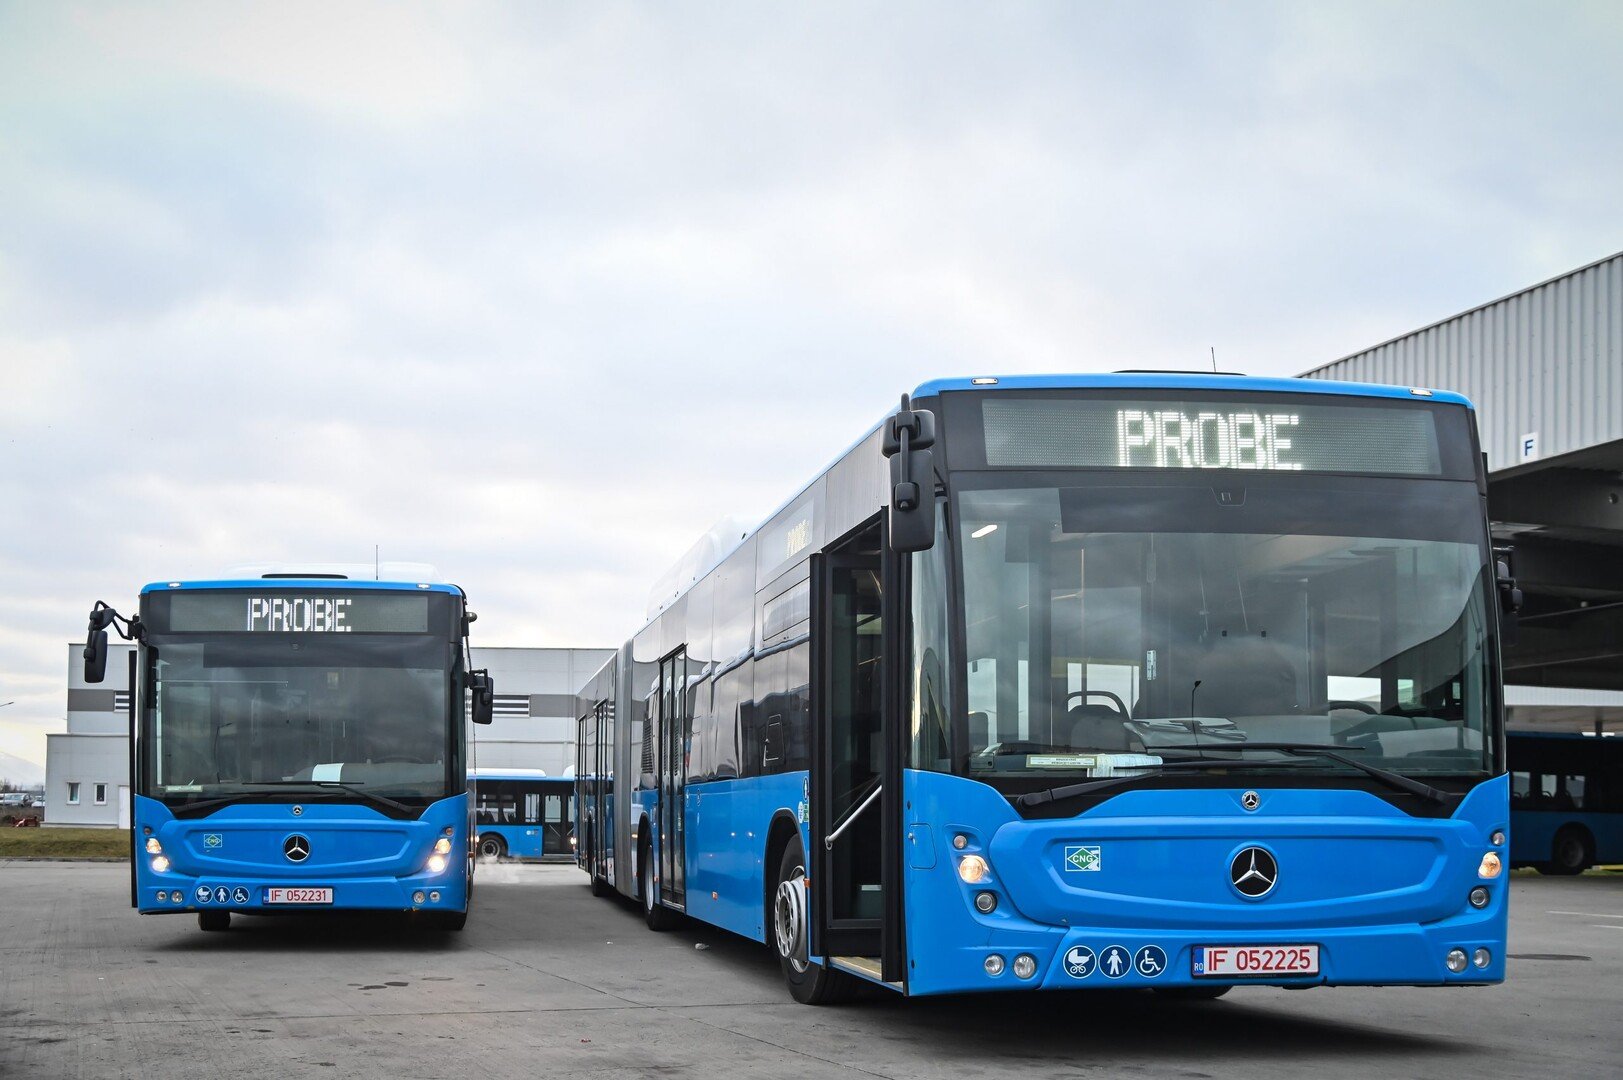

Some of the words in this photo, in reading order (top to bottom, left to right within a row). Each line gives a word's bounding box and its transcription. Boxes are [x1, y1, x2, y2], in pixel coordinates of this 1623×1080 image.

[1117, 410, 1302, 470] PROBE
[1525, 439, 1533, 456] F
[247, 598, 352, 632] PROBE
[1072, 854, 1094, 863] CNG
[271, 890, 282, 901] IF
[287, 890, 326, 901] 052231
[1194, 962, 1204, 971] RO
[1208, 950, 1228, 971] IF
[1236, 949, 1311, 971] 052225
